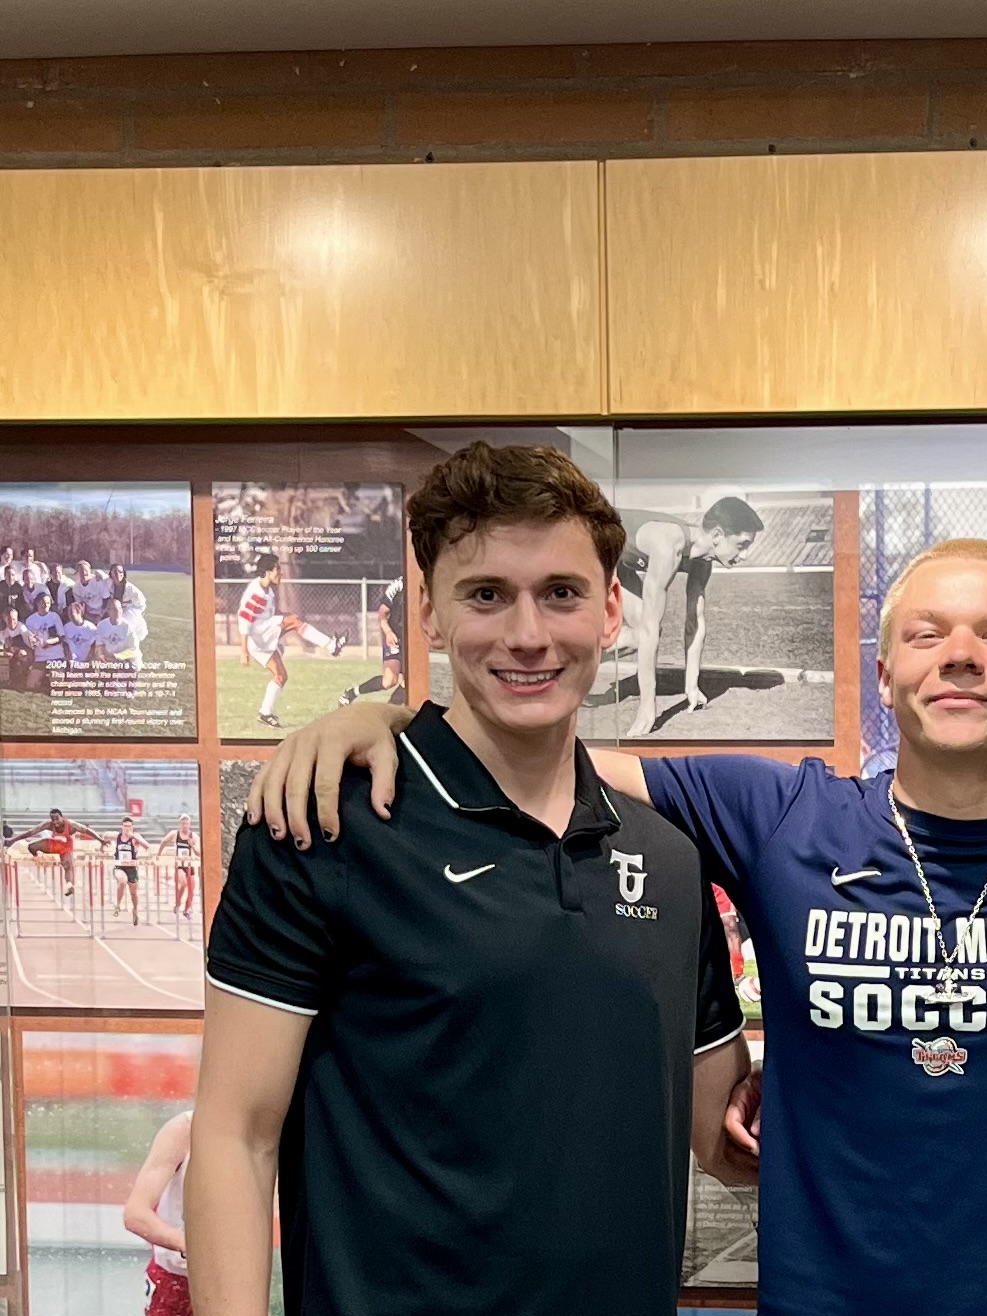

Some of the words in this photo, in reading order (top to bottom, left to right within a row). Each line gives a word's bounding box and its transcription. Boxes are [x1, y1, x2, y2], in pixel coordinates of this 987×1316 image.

[305, 544, 319, 552] 100
[46, 660, 67, 669] 2004
[69, 660, 90, 669] Titan
[163, 661, 187, 670] Team
[614, 902, 658, 920] SOCCER
[804, 908, 942, 964] DETROIT
